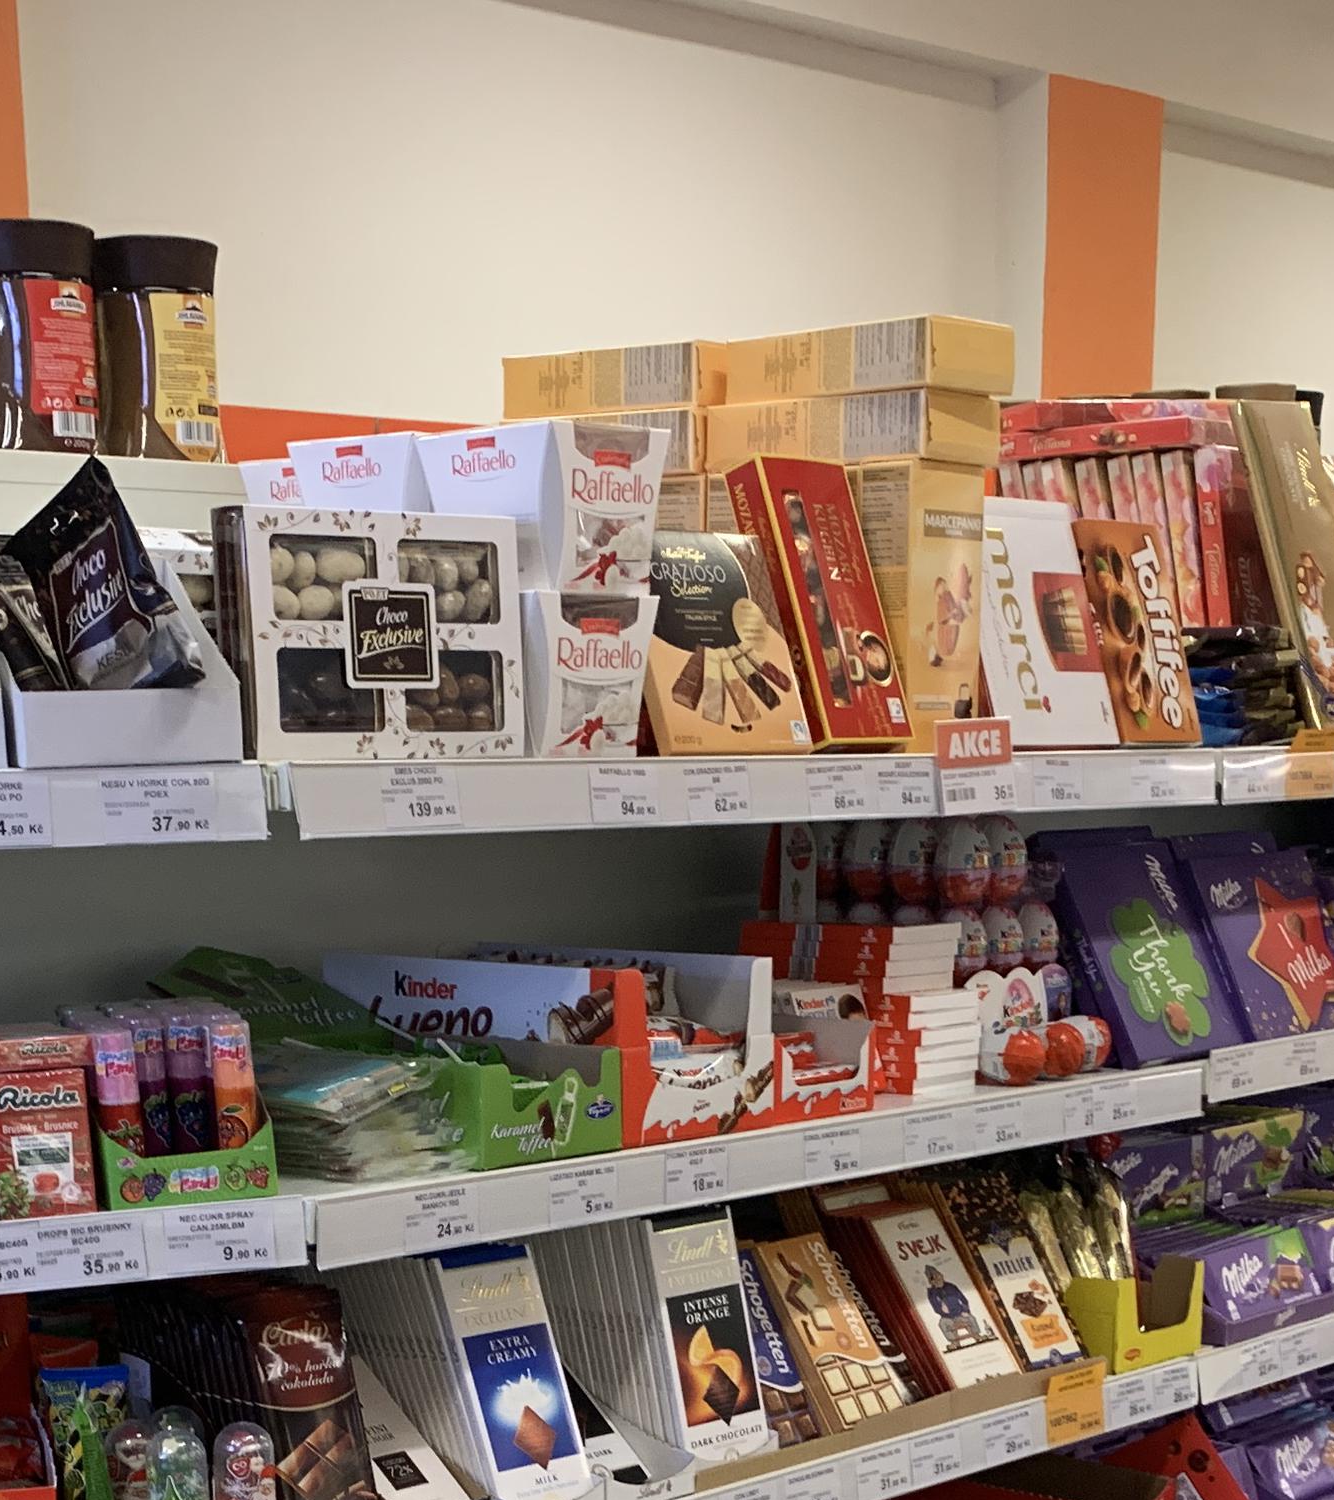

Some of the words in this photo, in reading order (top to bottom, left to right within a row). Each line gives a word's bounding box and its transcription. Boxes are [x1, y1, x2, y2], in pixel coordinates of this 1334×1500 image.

[321, 458, 382, 482] Raffaello
[452, 450, 516, 476] Raffaello
[570, 467, 655, 505] Raffaello
[650, 563, 726, 584] GRAZIOSO
[375, 607, 408, 626] Choco
[985, 527, 1042, 711] merci
[359, 626, 425, 657] Exclusive
[1131, 535, 1183, 729] Toffifee
[556, 637, 643, 671] Raffaello
[949, 730, 1000, 758] AKCE
[28, 823, 44, 834] Kč
[151, 816, 191, 832] 37,90
[194, 819, 210, 830] Kč
[1137, 915, 1193, 1003] Thank
[1286, 952, 1332, 990] Milka
[394, 970, 457, 1000] Kinder
[1128, 947, 1162, 1000] You
[490, 1120, 542, 1141] Karamel
[518, 1135, 553, 1155] Toffee
[1214, 1134, 1256, 1174] Milka
[223, 1246, 251, 1261] 9,90
[254, 1248, 268, 1258] Kč
[898, 1233, 947, 1261] ŠVEJK
[82, 1260, 121, 1276] 35,90
[124, 1260, 139, 1271] Kč
[992, 1258, 1034, 1278] ATELIER
[1220, 1255, 1263, 1298] Milka
[683, 1295, 728, 1311] INTENSE
[808, 1240, 867, 1349] Schogetten
[686, 1307, 731, 1325] ORANGE
[738, 1259, 791, 1376] Schogetten
[489, 1335, 529, 1350] EXTRA
[487, 1347, 538, 1365] CREAMY
[691, 1437, 713, 1450] DARK
[714, 1425, 763, 1444] CHOCOLATE
[1275, 1436, 1317, 1485] Milka
[534, 1474, 559, 1486] MILK
